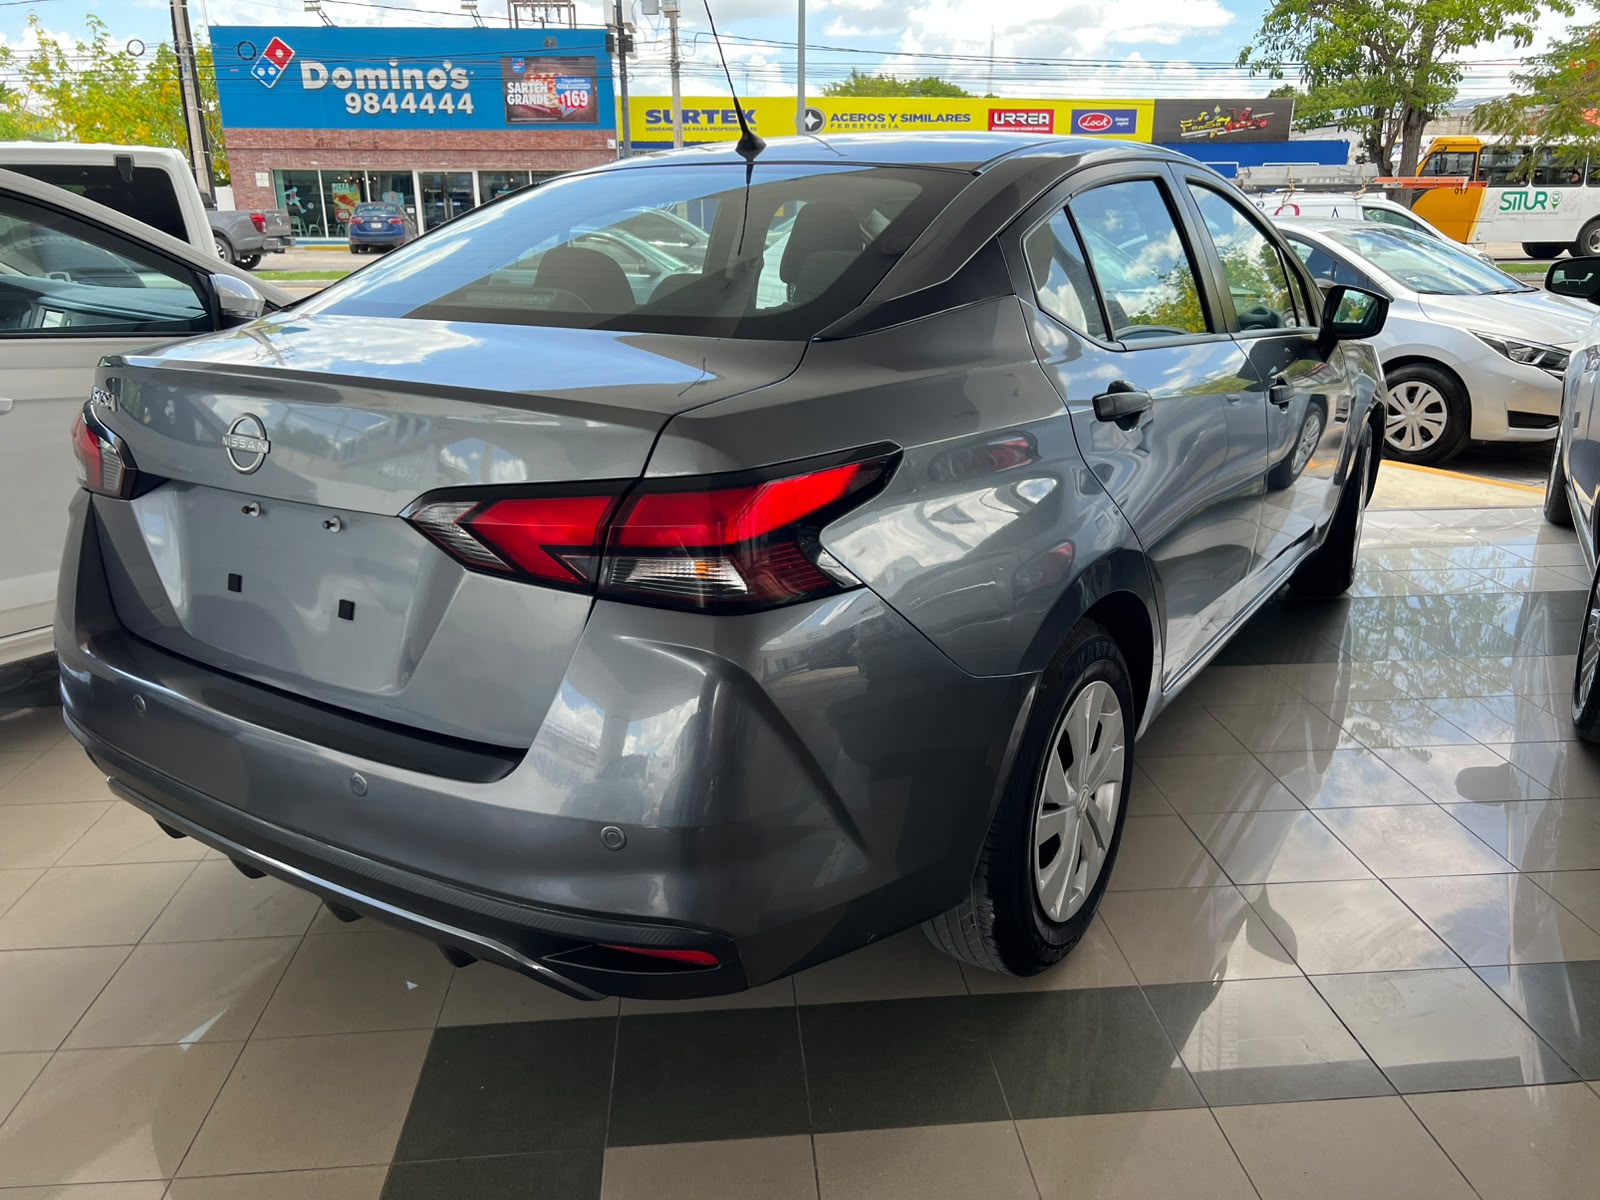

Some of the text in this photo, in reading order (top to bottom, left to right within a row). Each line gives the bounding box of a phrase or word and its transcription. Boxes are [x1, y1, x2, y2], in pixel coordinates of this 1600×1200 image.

[300, 58, 470, 90] Domino's
[345, 92, 474, 115] 9844444
[506, 93, 550, 105] GRANDE
[645, 109, 757, 124] SURTEK
[830, 113, 971, 123] ACEROS Y SIMILARES
[993, 112, 1050, 125] URREA
[1081, 116, 1109, 127] Lock
[1454, 187, 1469, 195] 017
[1499, 191, 1548, 211] SITUR
[222, 435, 269, 452] NISSAN
